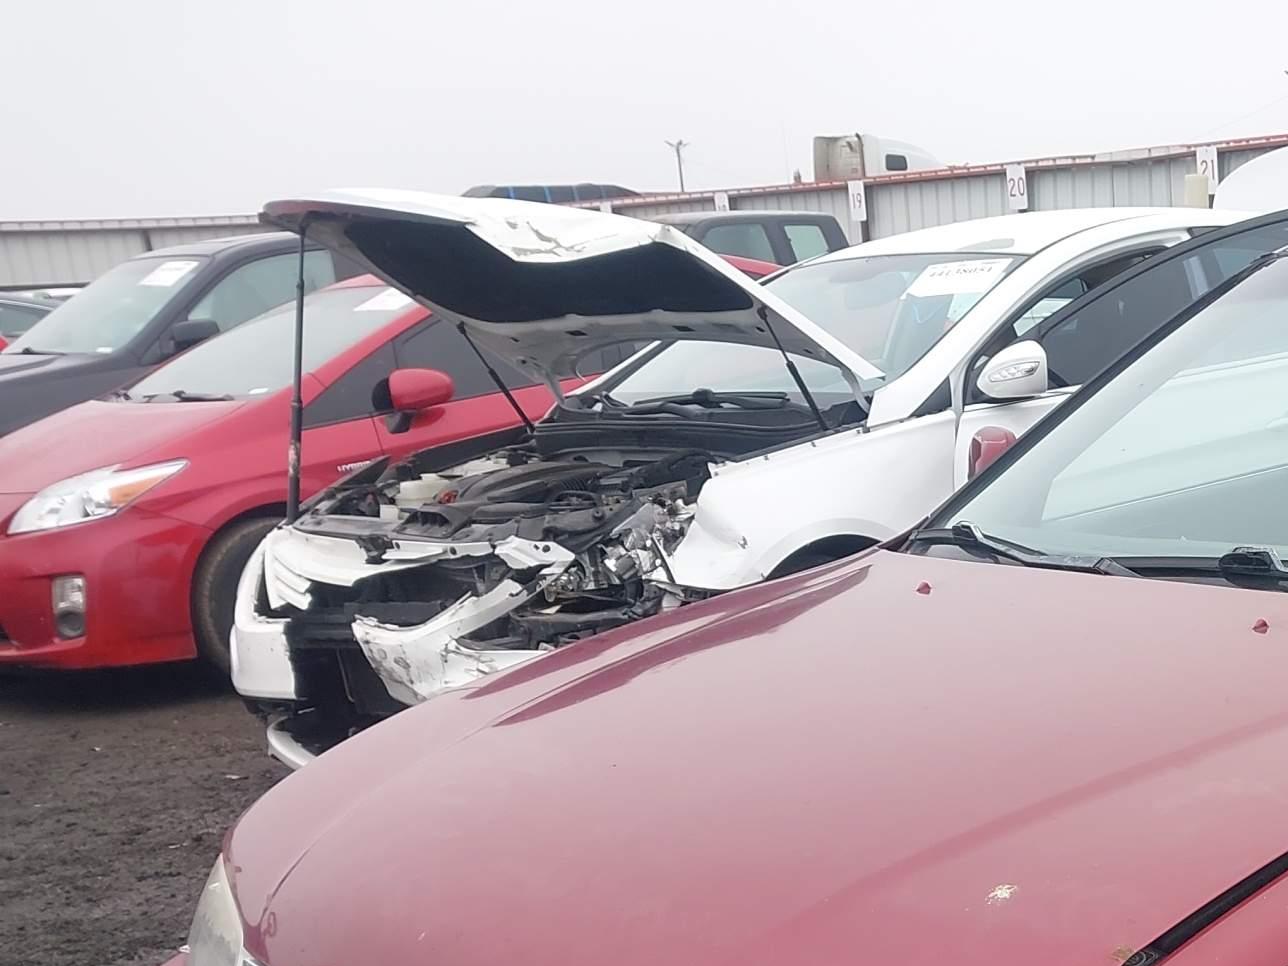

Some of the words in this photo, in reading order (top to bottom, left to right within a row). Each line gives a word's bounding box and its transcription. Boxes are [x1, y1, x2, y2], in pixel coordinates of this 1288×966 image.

[1199, 159, 1215, 181] 21
[1008, 176, 1025, 197] 20
[851, 192, 862, 209] 19
